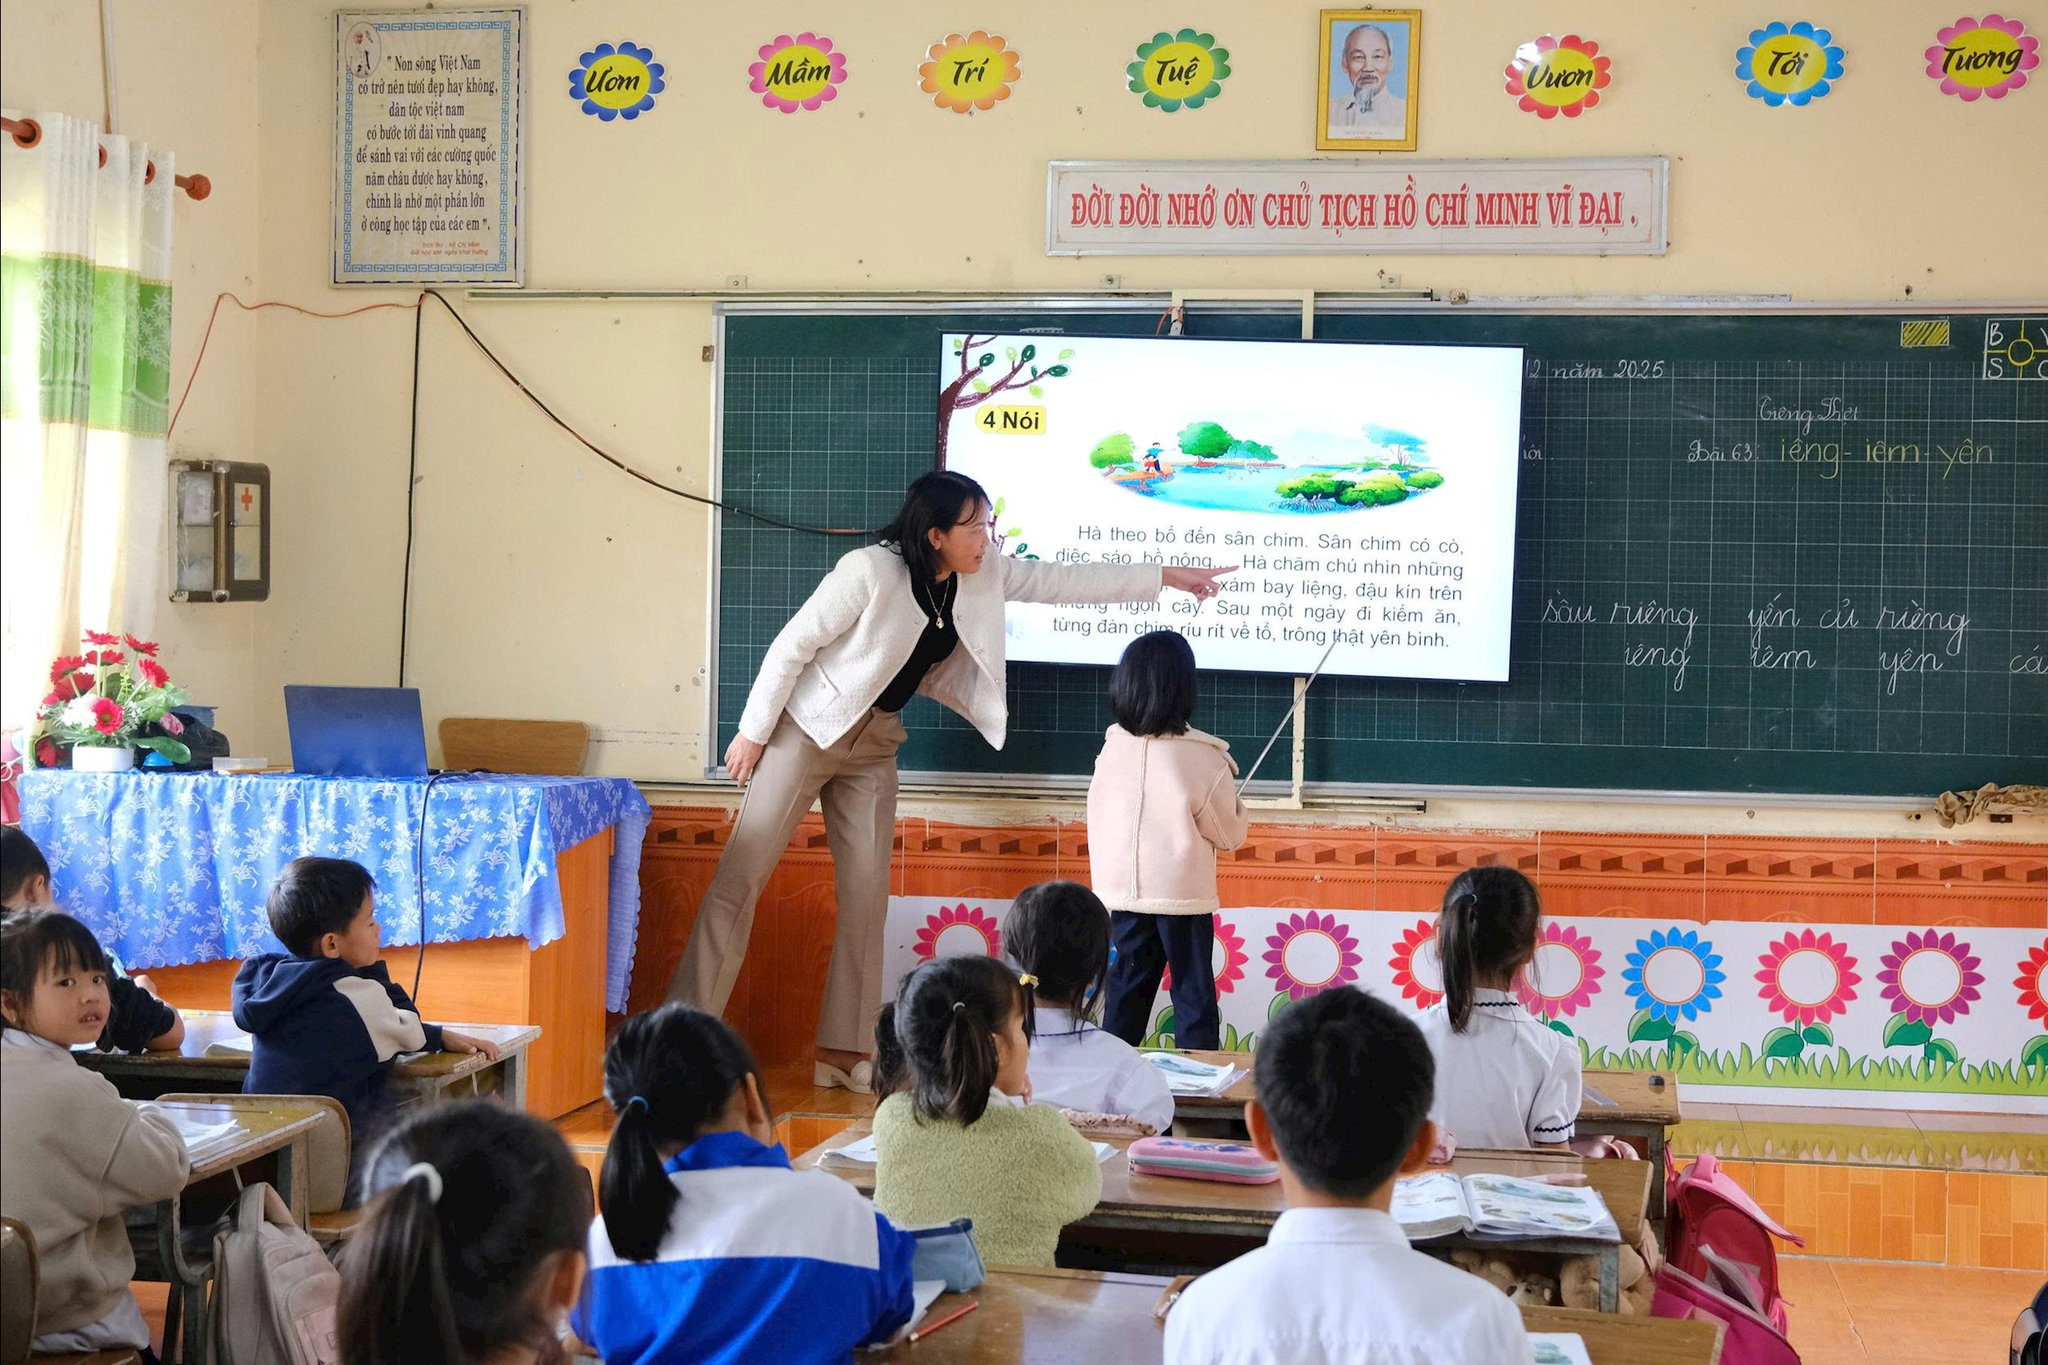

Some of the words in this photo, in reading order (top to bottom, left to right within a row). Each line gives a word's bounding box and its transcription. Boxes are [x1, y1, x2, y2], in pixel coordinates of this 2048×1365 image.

[394, 55, 413, 71] Non
[415, 56, 436, 74] sông
[439, 55, 458, 73] Việt
[460, 54, 481, 70] Nam
[586, 66, 640, 93] Ươm
[765, 57, 831, 88] Mầm
[953, 58, 989, 86] Trí
[1156, 56, 1200, 86] Tuệ
[1526, 63, 1594, 89] Vươn
[1768, 50, 1809, 77] Tới
[1942, 46, 2024, 75] Tương
[358, 79, 369, 95] có
[387, 79, 405, 94] nên
[427, 78, 445, 98] đẹp
[447, 77, 464, 97] hay
[466, 77, 498, 97] không,
[389, 101, 406, 117] dân
[409, 102, 423, 119] tộc
[425, 101, 443, 120] việt
[445, 104, 465, 116] nam
[366, 125, 377, 140] có
[379, 124, 401, 140] bước
[404, 124, 417, 140] tới
[436, 124, 456, 139] vinh
[458, 126, 487, 143] quang
[356, 144, 367, 163] để
[369, 147, 392, 163] sánh
[394, 147, 408, 163] vai
[410, 146, 425, 163] với
[426, 147, 442, 162] các
[474, 143, 497, 166] quốc
[365, 171, 385, 186] năm
[387, 170, 410, 185] châu
[412, 169, 434, 189] được
[436, 169, 452, 189] hay
[455, 169, 488, 188] không,
[366, 193, 391, 209] chính
[393, 193, 402, 209] là
[424, 193, 442, 211] một
[444, 190, 468, 212] phần
[470, 192, 485, 208] lớn
[1071, 183, 1112, 226] ĐỜI
[1119, 183, 1161, 226] ĐỜI
[1167, 183, 1216, 226] NHỚ
[1224, 188, 1255, 226] ƠN
[1262, 180, 1311, 226] CHỦ
[1319, 192, 1377, 235] TỊCH
[1383, 174, 1418, 227] HỒ
[1425, 183, 1468, 226] CHÍ
[1475, 192, 1540, 225] MINH
[1546, 184, 1572, 225] VĨ
[1579, 192, 1623, 233] ĐẠI
[369, 217, 392, 236] công
[393, 216, 410, 235] học
[412, 216, 427, 235] tập
[429, 214, 446, 231] của
[448, 216, 463, 231] các
[466, 219, 480, 230] em
[1990, 322, 2003, 346] B
[1551, 363, 1604, 379] năm
[1614, 359, 1665, 379] 2025
[1987, 357, 2003, 379] S
[983, 410, 996, 428] 4
[1003, 410, 1039, 429] Nói
[1781, 438, 1839, 480] iêng
[1866, 438, 1920, 463] iêm
[1937, 438, 1993, 480] yên
[1079, 525, 1101, 541] Hà
[1110, 527, 1147, 542] theo
[1155, 524, 1176, 543] bố
[1184, 526, 1216, 544] đến
[1224, 530, 1255, 546] sân
[1263, 532, 1308, 548] chim.
[1318, 533, 1351, 549] Sân
[1360, 536, 1400, 551] chim
[1410, 537, 1430, 553] có
[1439, 538, 1464, 556] cò,
[1243, 554, 1267, 569] Hà
[1273, 556, 1320, 572] chăm
[1326, 558, 1357, 573] chú
[1364, 559, 1400, 575] nhìn
[1407, 561, 1463, 581] những
[1220, 579, 1255, 593] xám
[1263, 579, 1294, 598] bay
[1302, 580, 1347, 600] liệng,
[1356, 583, 1387, 601] đậu
[1395, 584, 1421, 599] kín
[1430, 585, 1462, 601] trên
[1172, 599, 1204, 615] cây.
[1217, 600, 1250, 616] Sau
[1261, 603, 1293, 620] một
[1304, 605, 1346, 623] ngày
[1357, 606, 1371, 621] đi
[1383, 605, 1423, 623] kiếm
[1435, 609, 1461, 626] ăn,
[1541, 590, 1596, 623] sầu
[1609, 600, 1698, 649] riêng
[1748, 592, 1800, 649] yến
[1820, 598, 1859, 629] củ
[1875, 599, 1971, 656] riềng
[1053, 617, 1091, 636] từng
[1097, 619, 1128, 634] đàn
[1180, 623, 1200, 637] ríu
[1208, 623, 1224, 638] rít
[1230, 621, 1250, 640] về
[1256, 621, 1276, 641] tổ,
[1283, 627, 1326, 646] trông
[1332, 629, 1364, 647] thật
[1370, 630, 1400, 648] yên
[1407, 632, 1449, 647] bình.
[1624, 642, 1691, 692] iêng
[1751, 645, 1816, 669] iêm
[1879, 647, 1944, 696] yên
